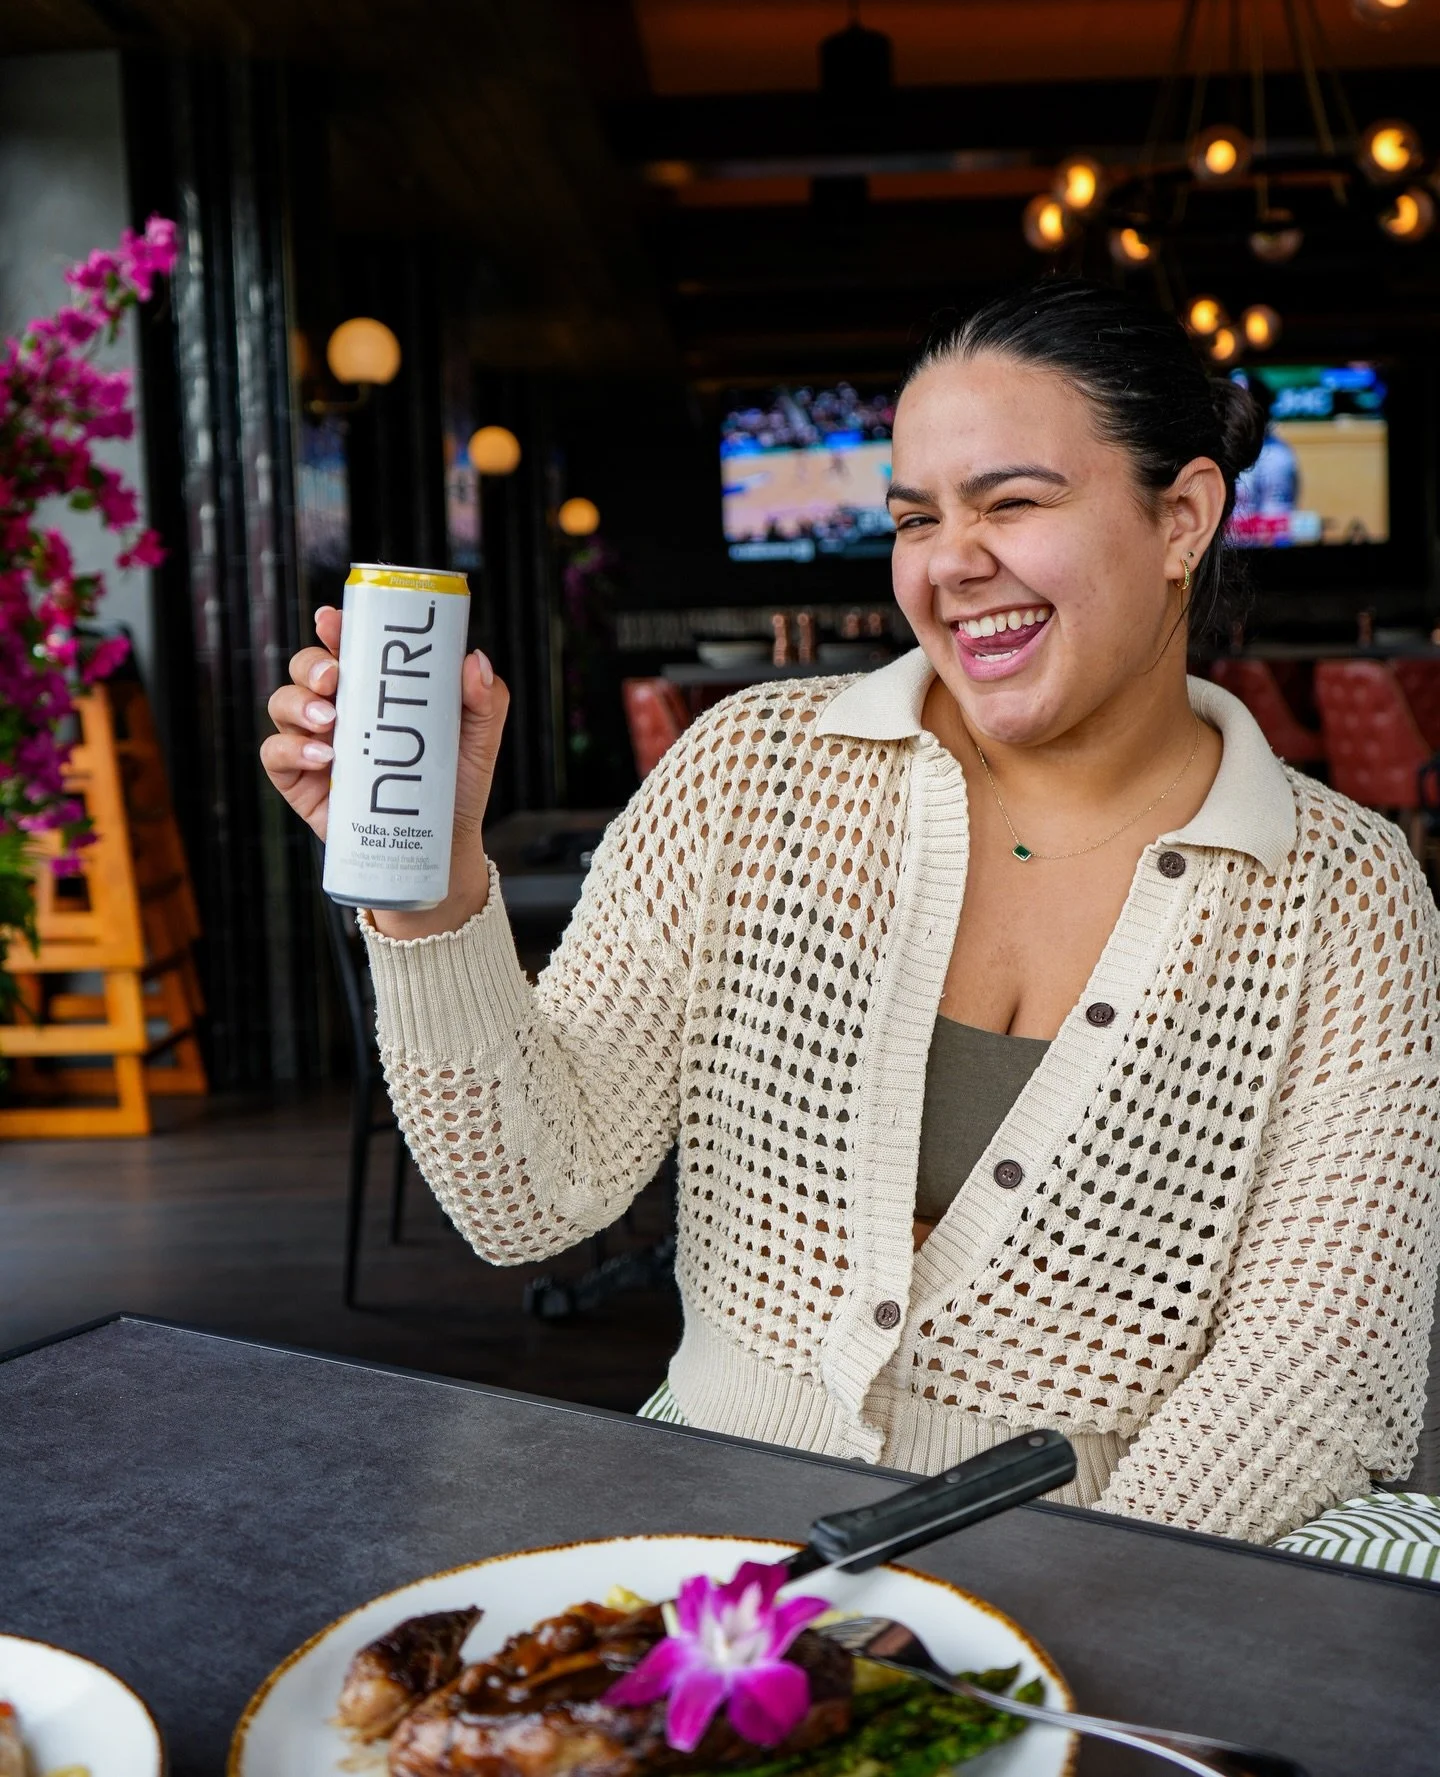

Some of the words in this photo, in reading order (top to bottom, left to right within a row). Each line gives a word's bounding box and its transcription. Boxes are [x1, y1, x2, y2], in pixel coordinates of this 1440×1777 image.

[389, 574, 436, 589] Pineapple
[351, 823, 390, 836] Vodka.
[393, 827, 434, 838] Seltzer.
[361, 836, 386, 848] Real
[389, 838, 423, 850] Juice.
